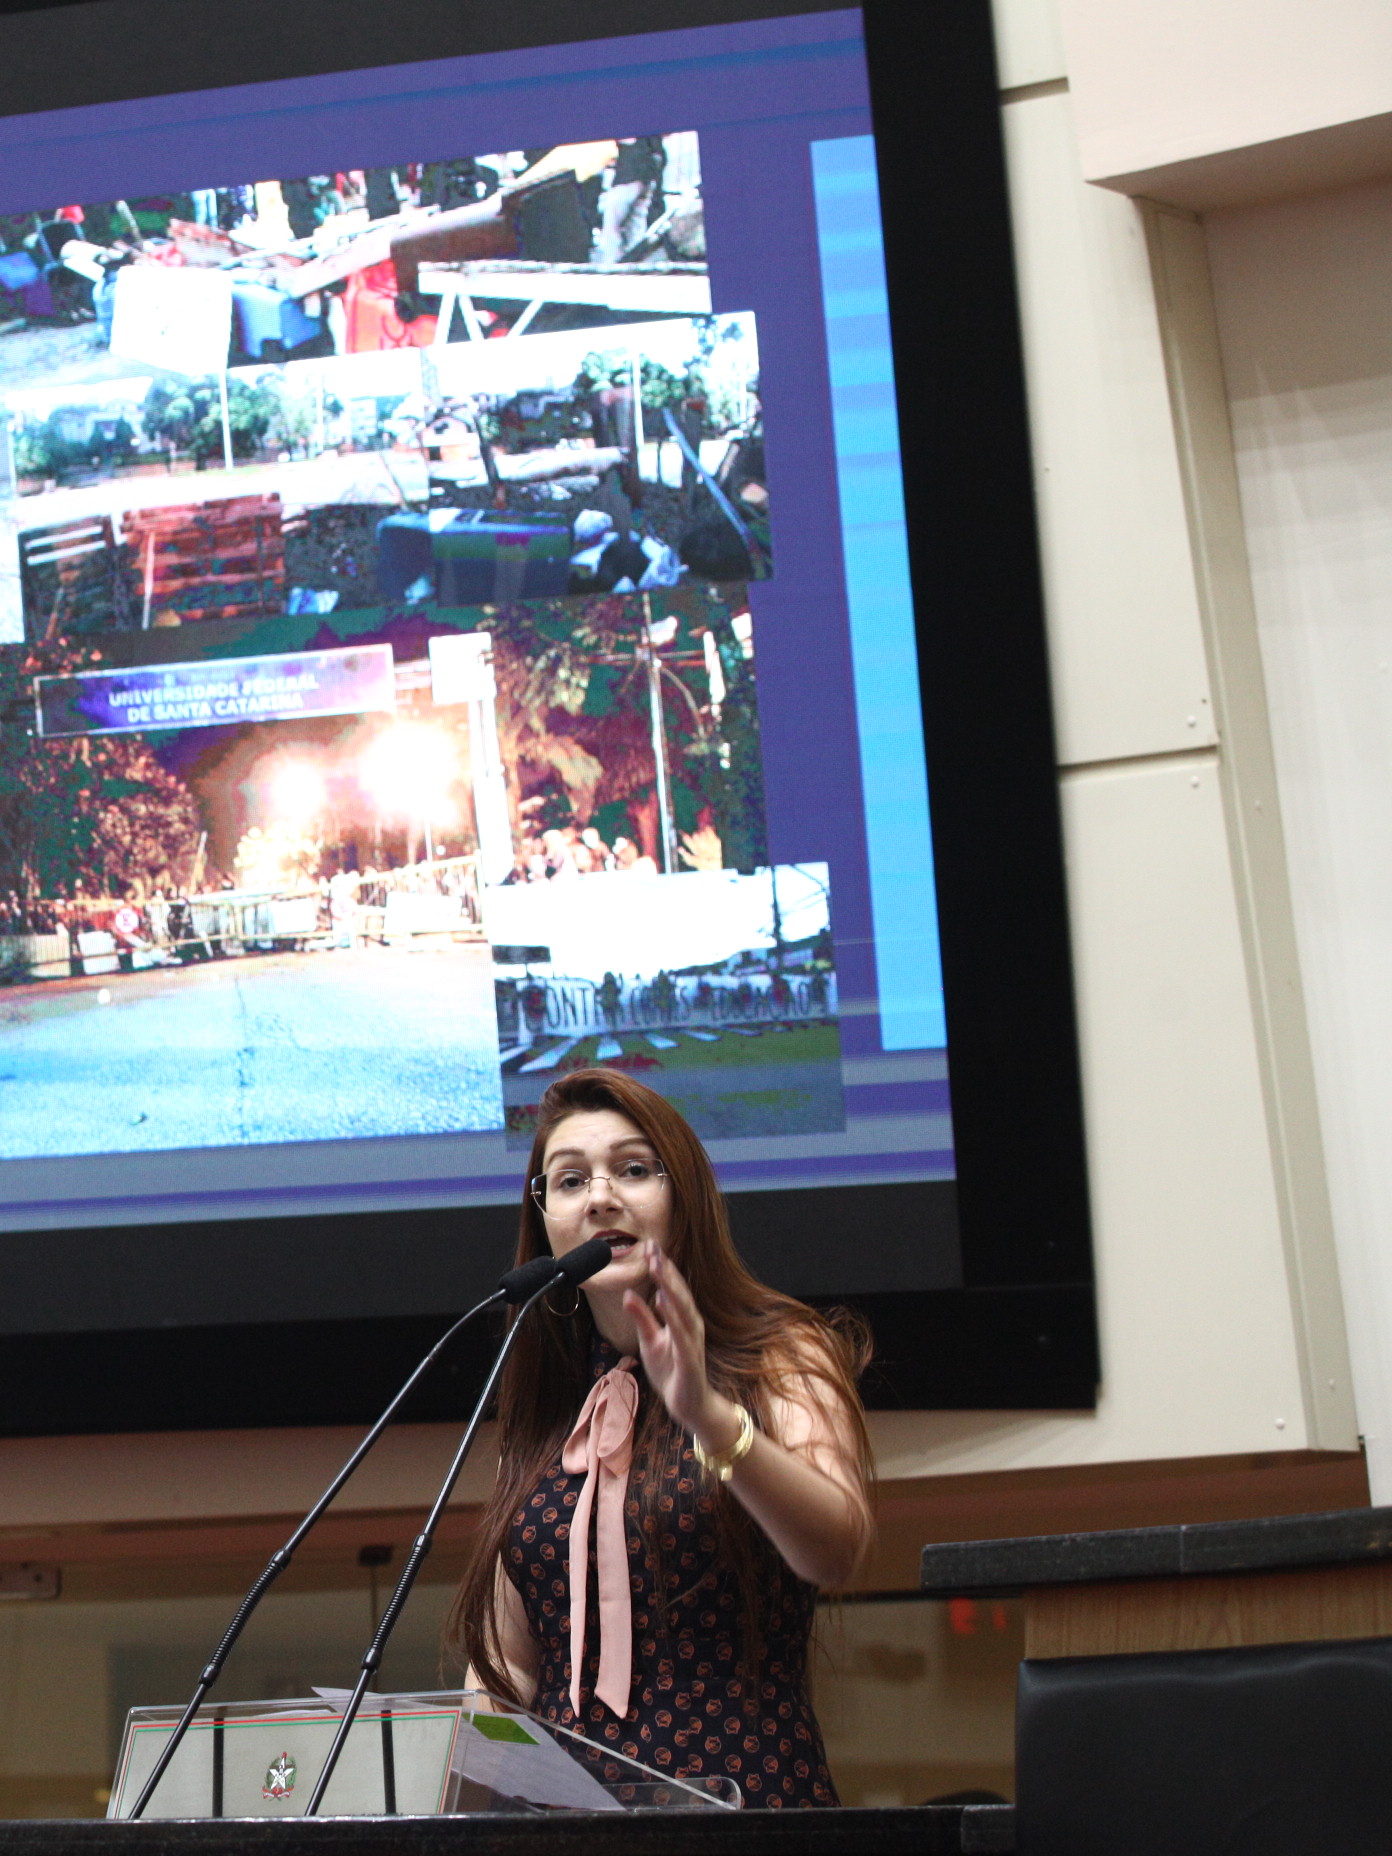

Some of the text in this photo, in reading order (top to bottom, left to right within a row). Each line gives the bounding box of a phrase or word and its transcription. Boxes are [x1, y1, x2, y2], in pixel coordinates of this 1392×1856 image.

[109, 682, 240, 707] UNIVERSIDADE
[242, 673, 320, 696] FEDERAL
[127, 693, 304, 723] DE SANTA CATARINA
